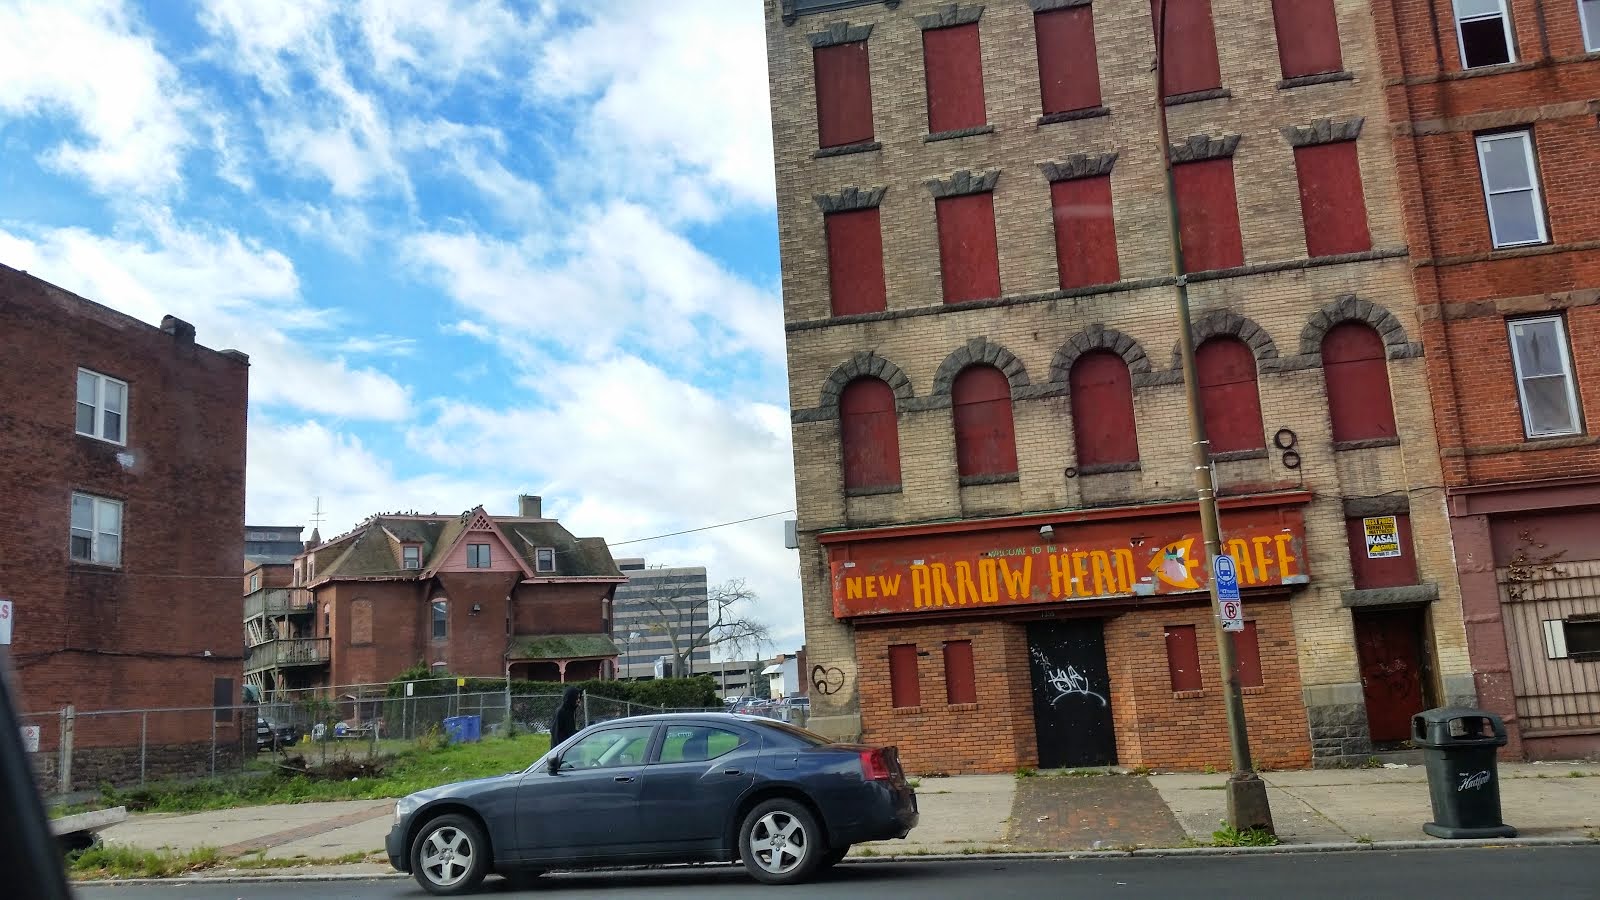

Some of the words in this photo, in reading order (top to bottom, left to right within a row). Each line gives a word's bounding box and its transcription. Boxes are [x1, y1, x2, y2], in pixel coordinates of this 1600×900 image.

[846, 574, 901, 599] NEW
[910, 555, 1032, 608] ARROW
[1049, 548, 1137, 598] HEAD
[1222, 533, 1295, 585] AFE
[1031, 546, 1042, 555] TO
